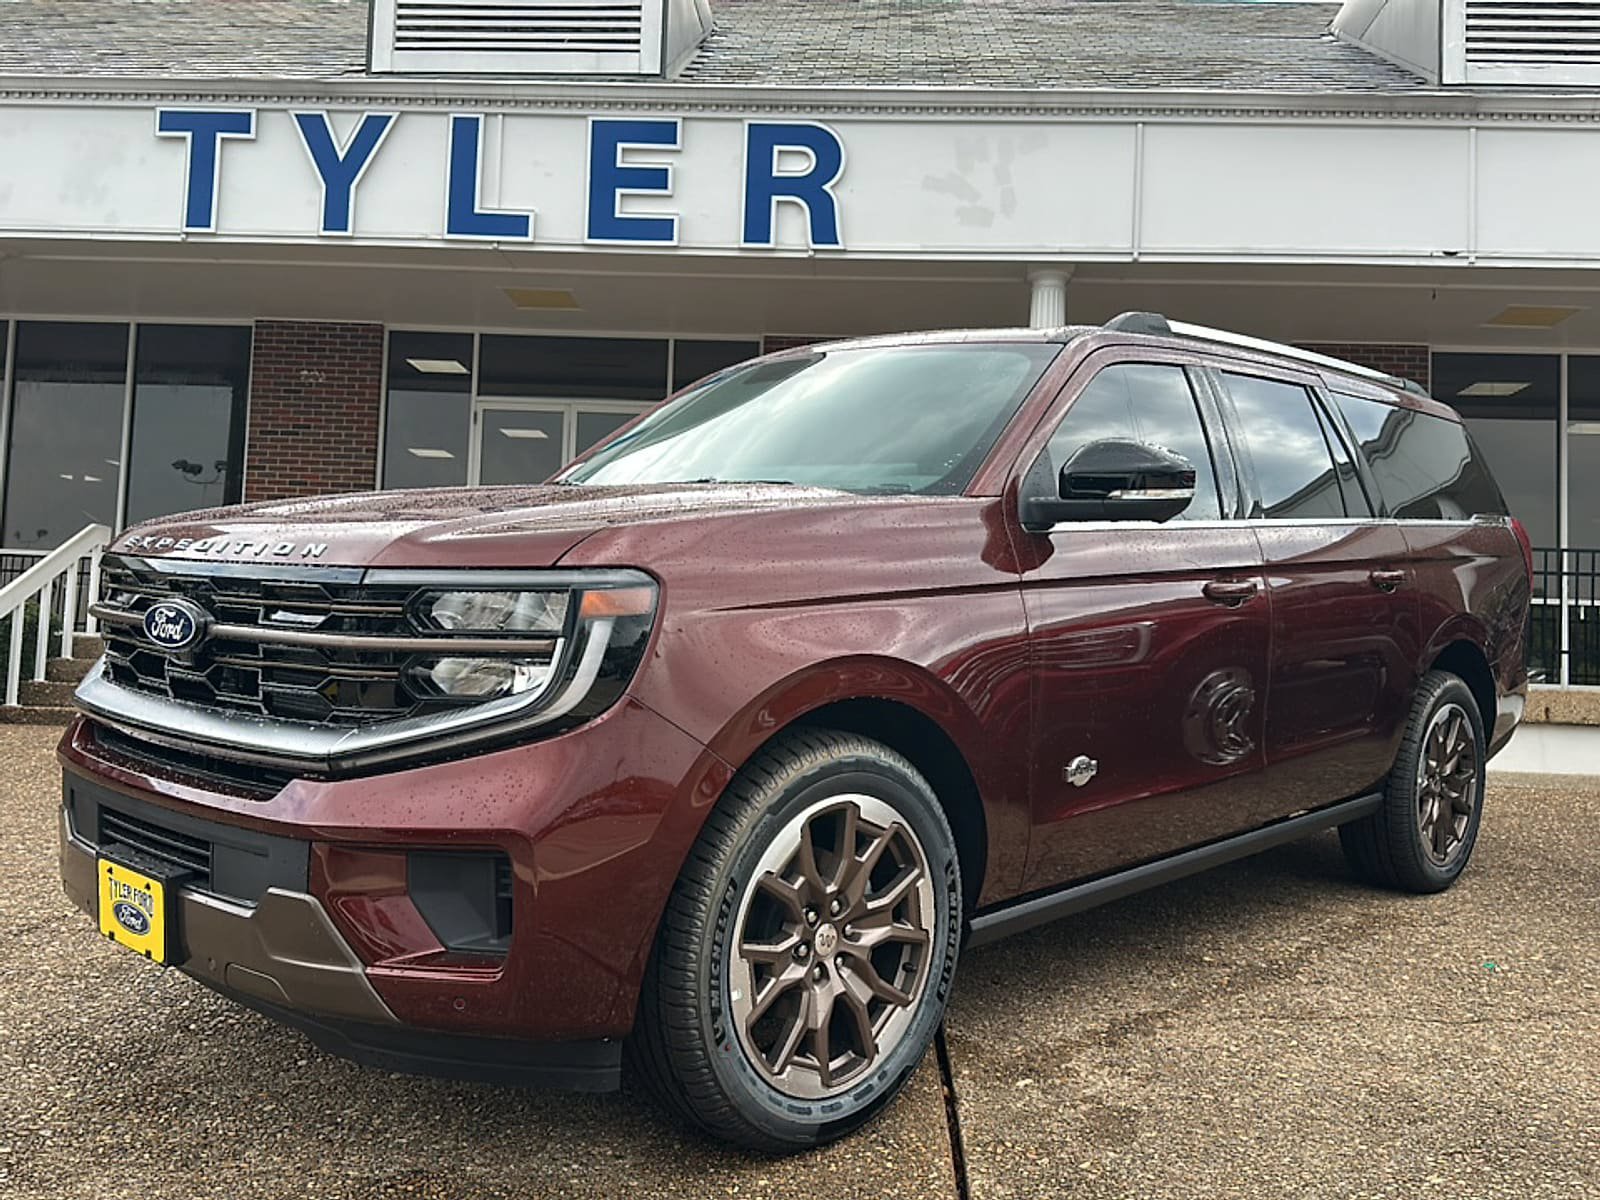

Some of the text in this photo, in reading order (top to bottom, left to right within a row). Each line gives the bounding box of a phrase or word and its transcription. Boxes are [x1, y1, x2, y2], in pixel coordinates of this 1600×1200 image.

[155, 107, 846, 250] TYLER
[123, 535, 329, 558] EXPEDITION
[151, 607, 184, 640] Ford
[108, 877, 131, 901] TYLER
[118, 904, 144, 931] Ford
[711, 883, 737, 1010] MICHELIN
